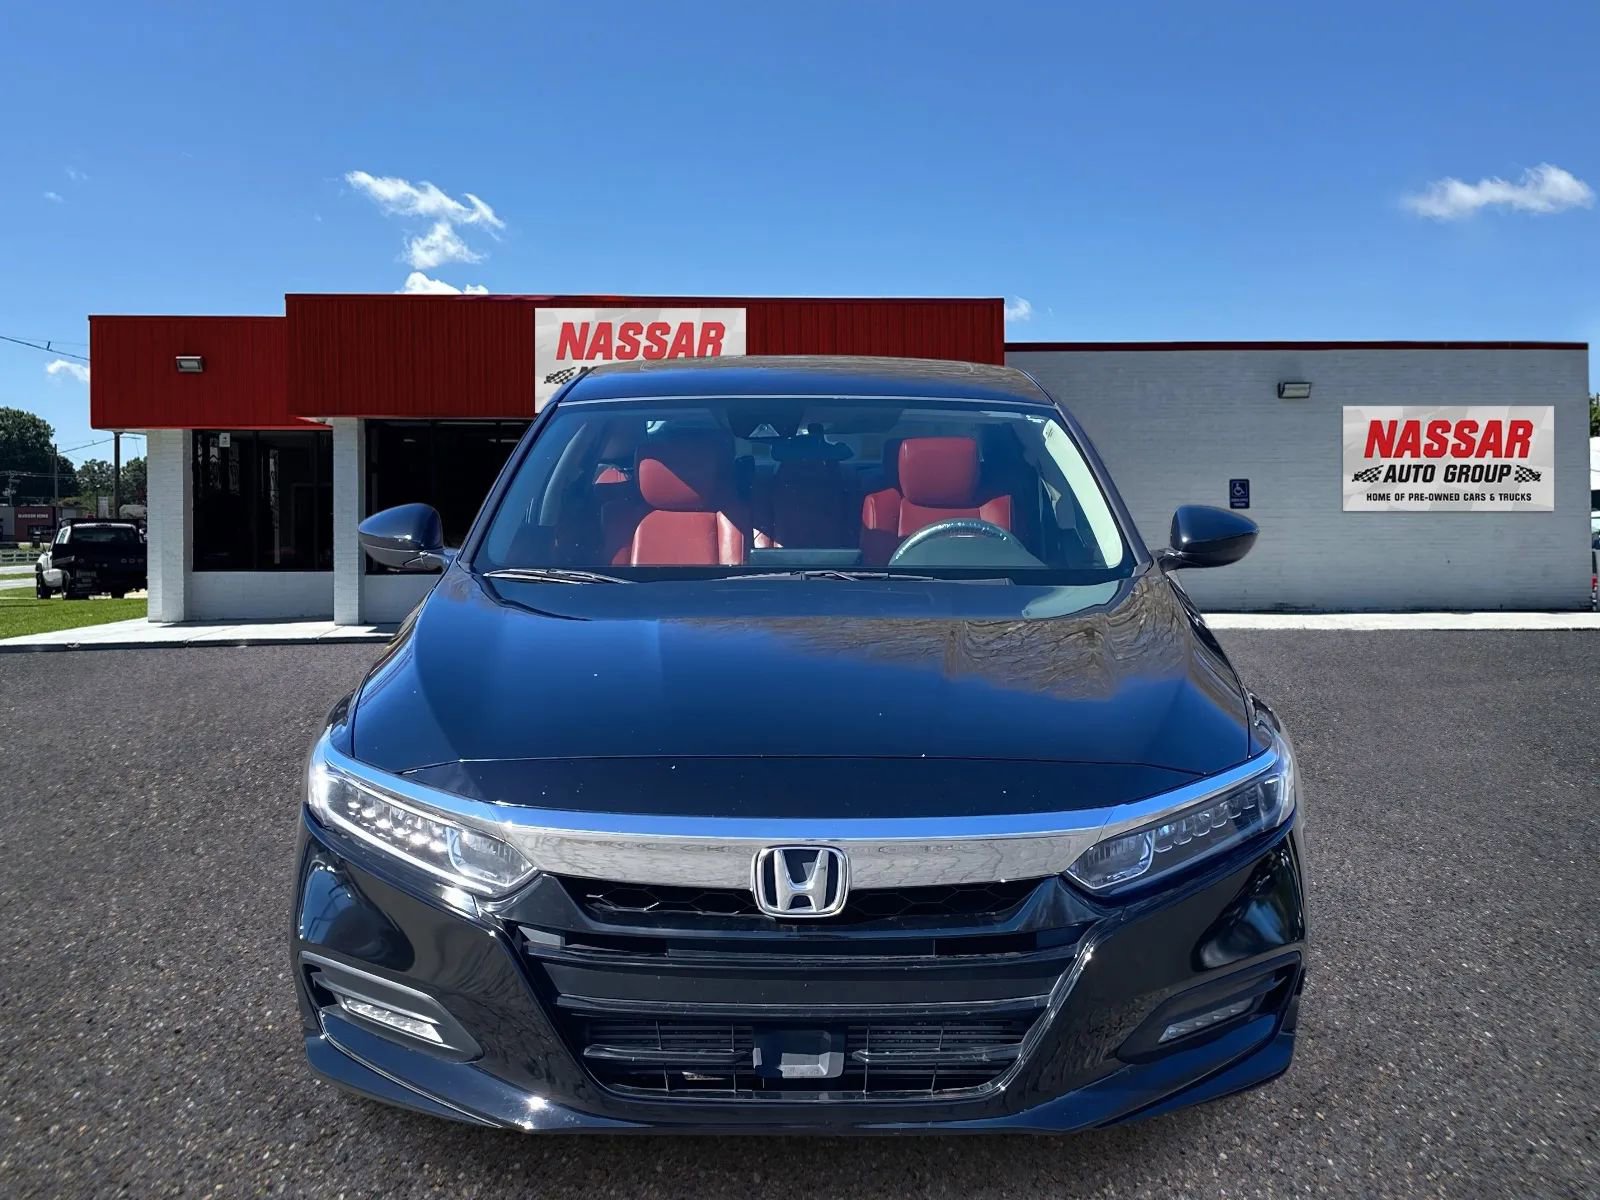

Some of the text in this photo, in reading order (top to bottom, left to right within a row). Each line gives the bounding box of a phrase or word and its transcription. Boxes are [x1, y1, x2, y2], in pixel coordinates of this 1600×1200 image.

[556, 322, 726, 361] NASSAR
[1364, 419, 1534, 459] NASSAR
[1383, 464, 1512, 483] AUTO GROUP
[1366, 492, 1391, 502] HOME
[1394, 492, 1405, 502] OF
[1408, 492, 1460, 502] PRE-OWNED
[1463, 492, 1486, 502] CARS
[1498, 492, 1532, 502] TRUCKS
